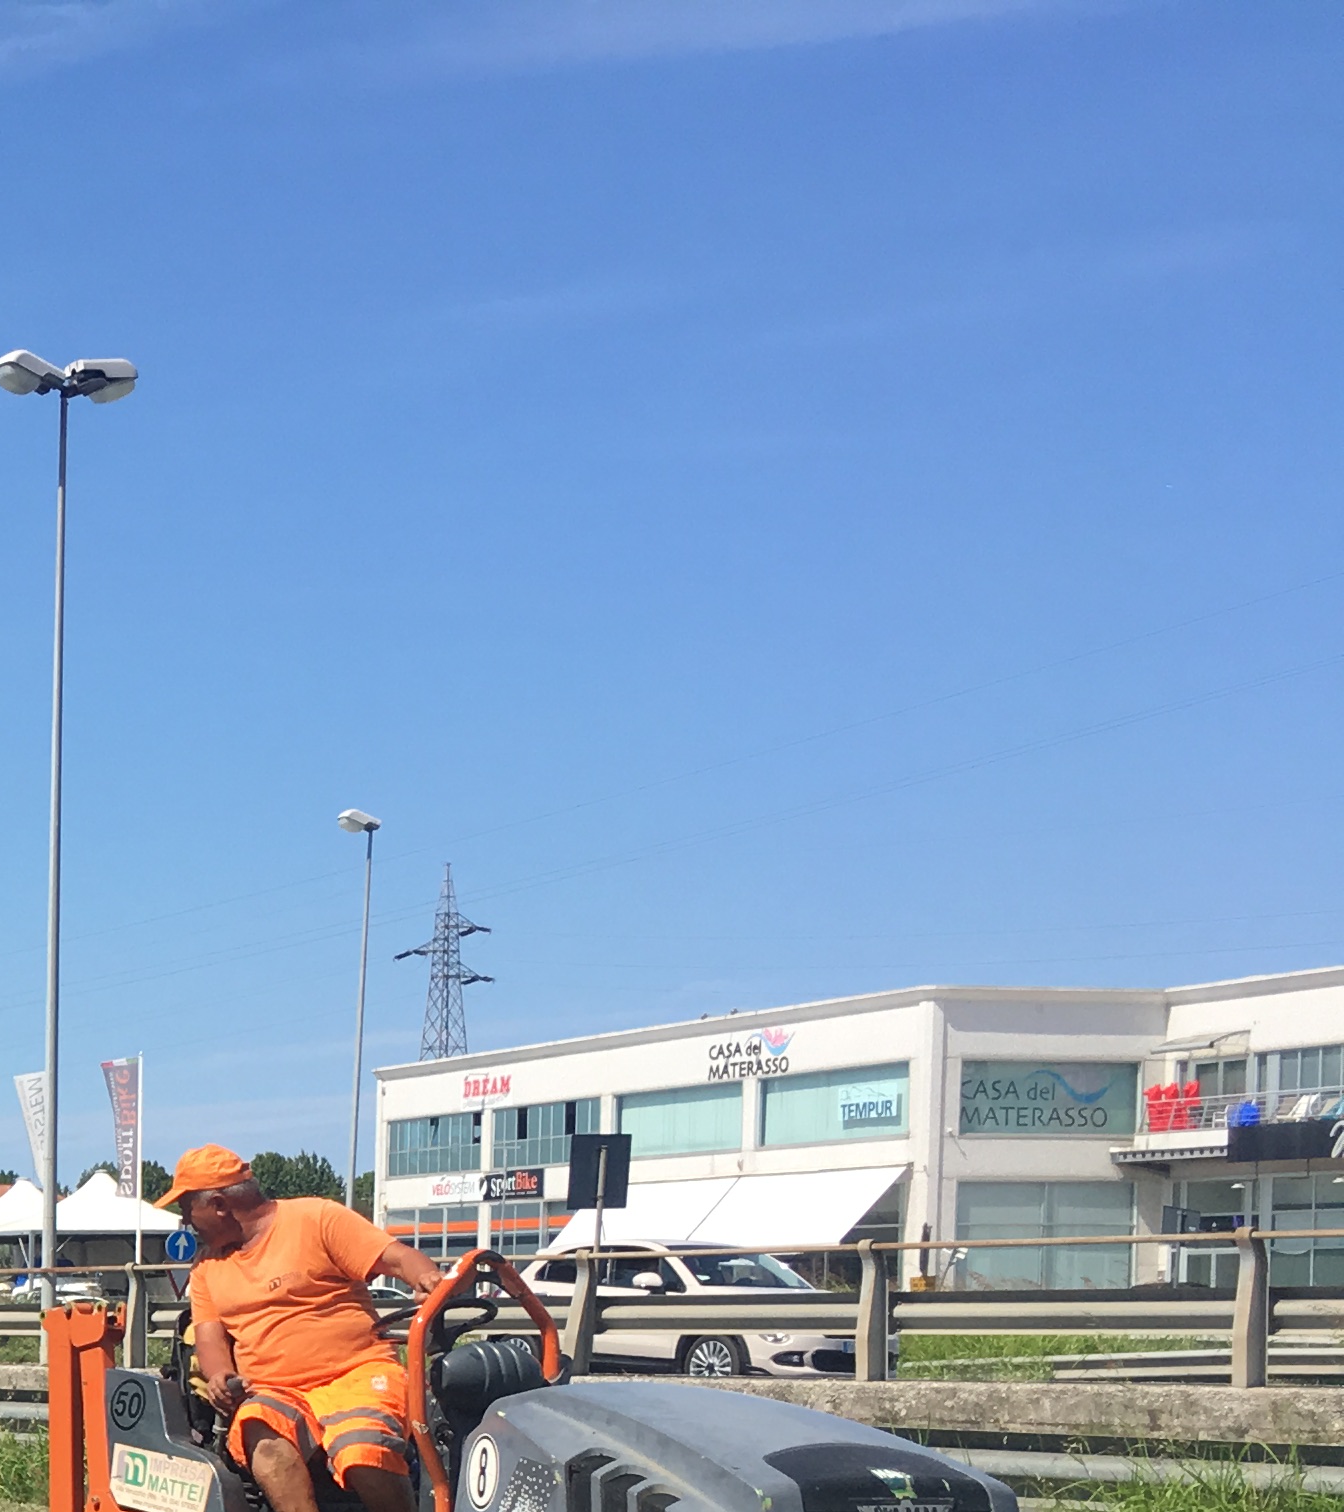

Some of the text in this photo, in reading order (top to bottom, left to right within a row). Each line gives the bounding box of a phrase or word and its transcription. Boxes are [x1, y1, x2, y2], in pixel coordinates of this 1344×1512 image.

[709, 1039, 762, 1060] CASA del
[708, 1056, 789, 1081] MATERASSO
[463, 1075, 511, 1098] DREAM
[962, 1080, 1056, 1101] CASA del
[840, 1099, 893, 1121] TEMPUR
[961, 1106, 1108, 1128] MATERASSO
[114, 1390, 142, 1419] 50
[149, 1457, 206, 1482] IMPRESA
[477, 1447, 488, 1498] 8
[147, 1474, 205, 1502] MATTEI
